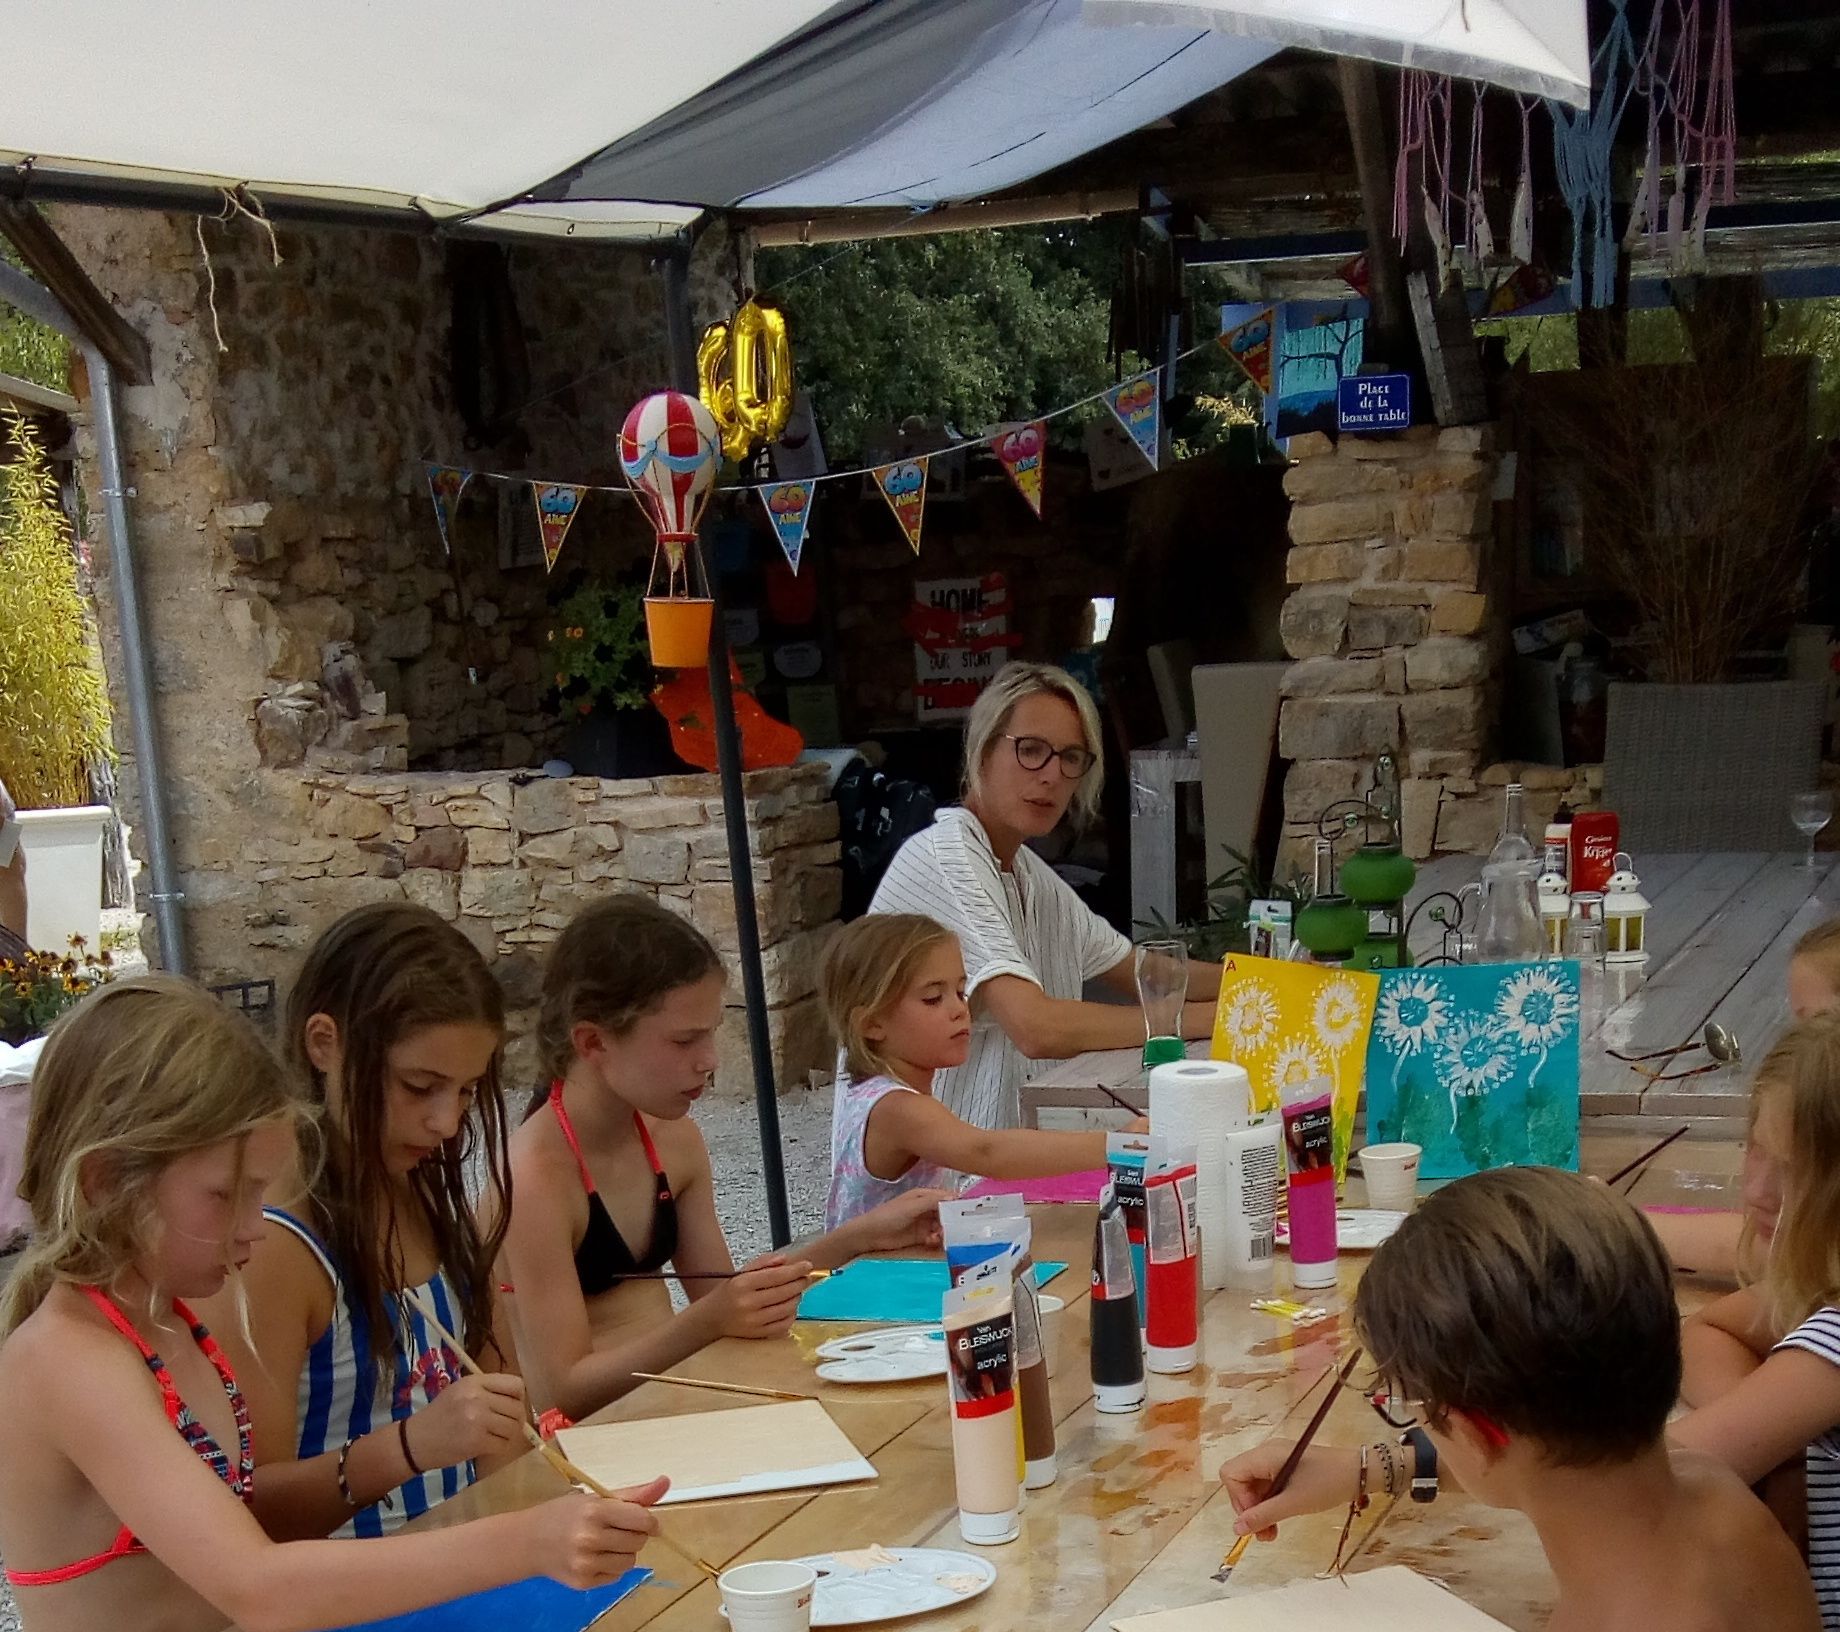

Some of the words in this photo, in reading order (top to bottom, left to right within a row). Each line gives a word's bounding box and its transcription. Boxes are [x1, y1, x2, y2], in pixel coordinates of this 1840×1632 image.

[1003, 427, 1040, 462] 60
[884, 463, 923, 495] 60
[769, 485, 807, 513] 60
[977, 1353, 1007, 1370] acrylic
